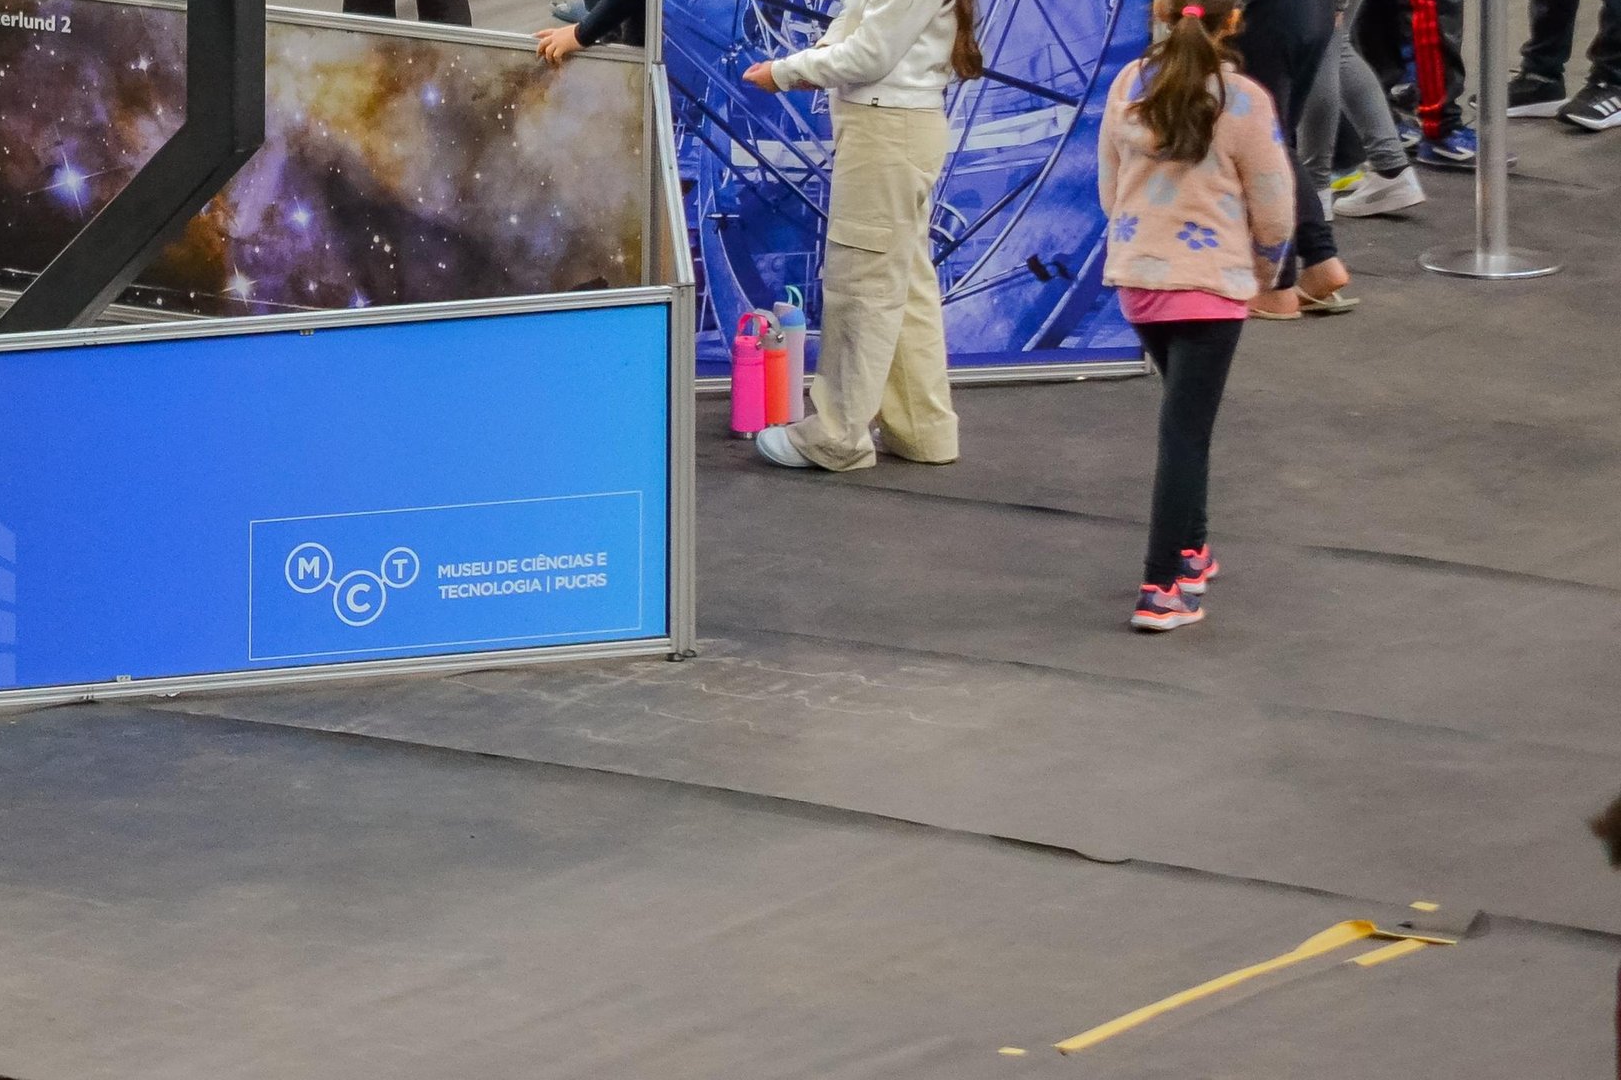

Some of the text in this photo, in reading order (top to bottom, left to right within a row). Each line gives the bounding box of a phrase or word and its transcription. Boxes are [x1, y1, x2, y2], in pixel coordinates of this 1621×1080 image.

[61, 16, 71, 33] 2
[438, 552, 607, 579] MUSEU DE CIÊNCIAS E
[298, 556, 408, 613] M C T
[438, 573, 607, 600] TECNOLOGIA PUCRS
